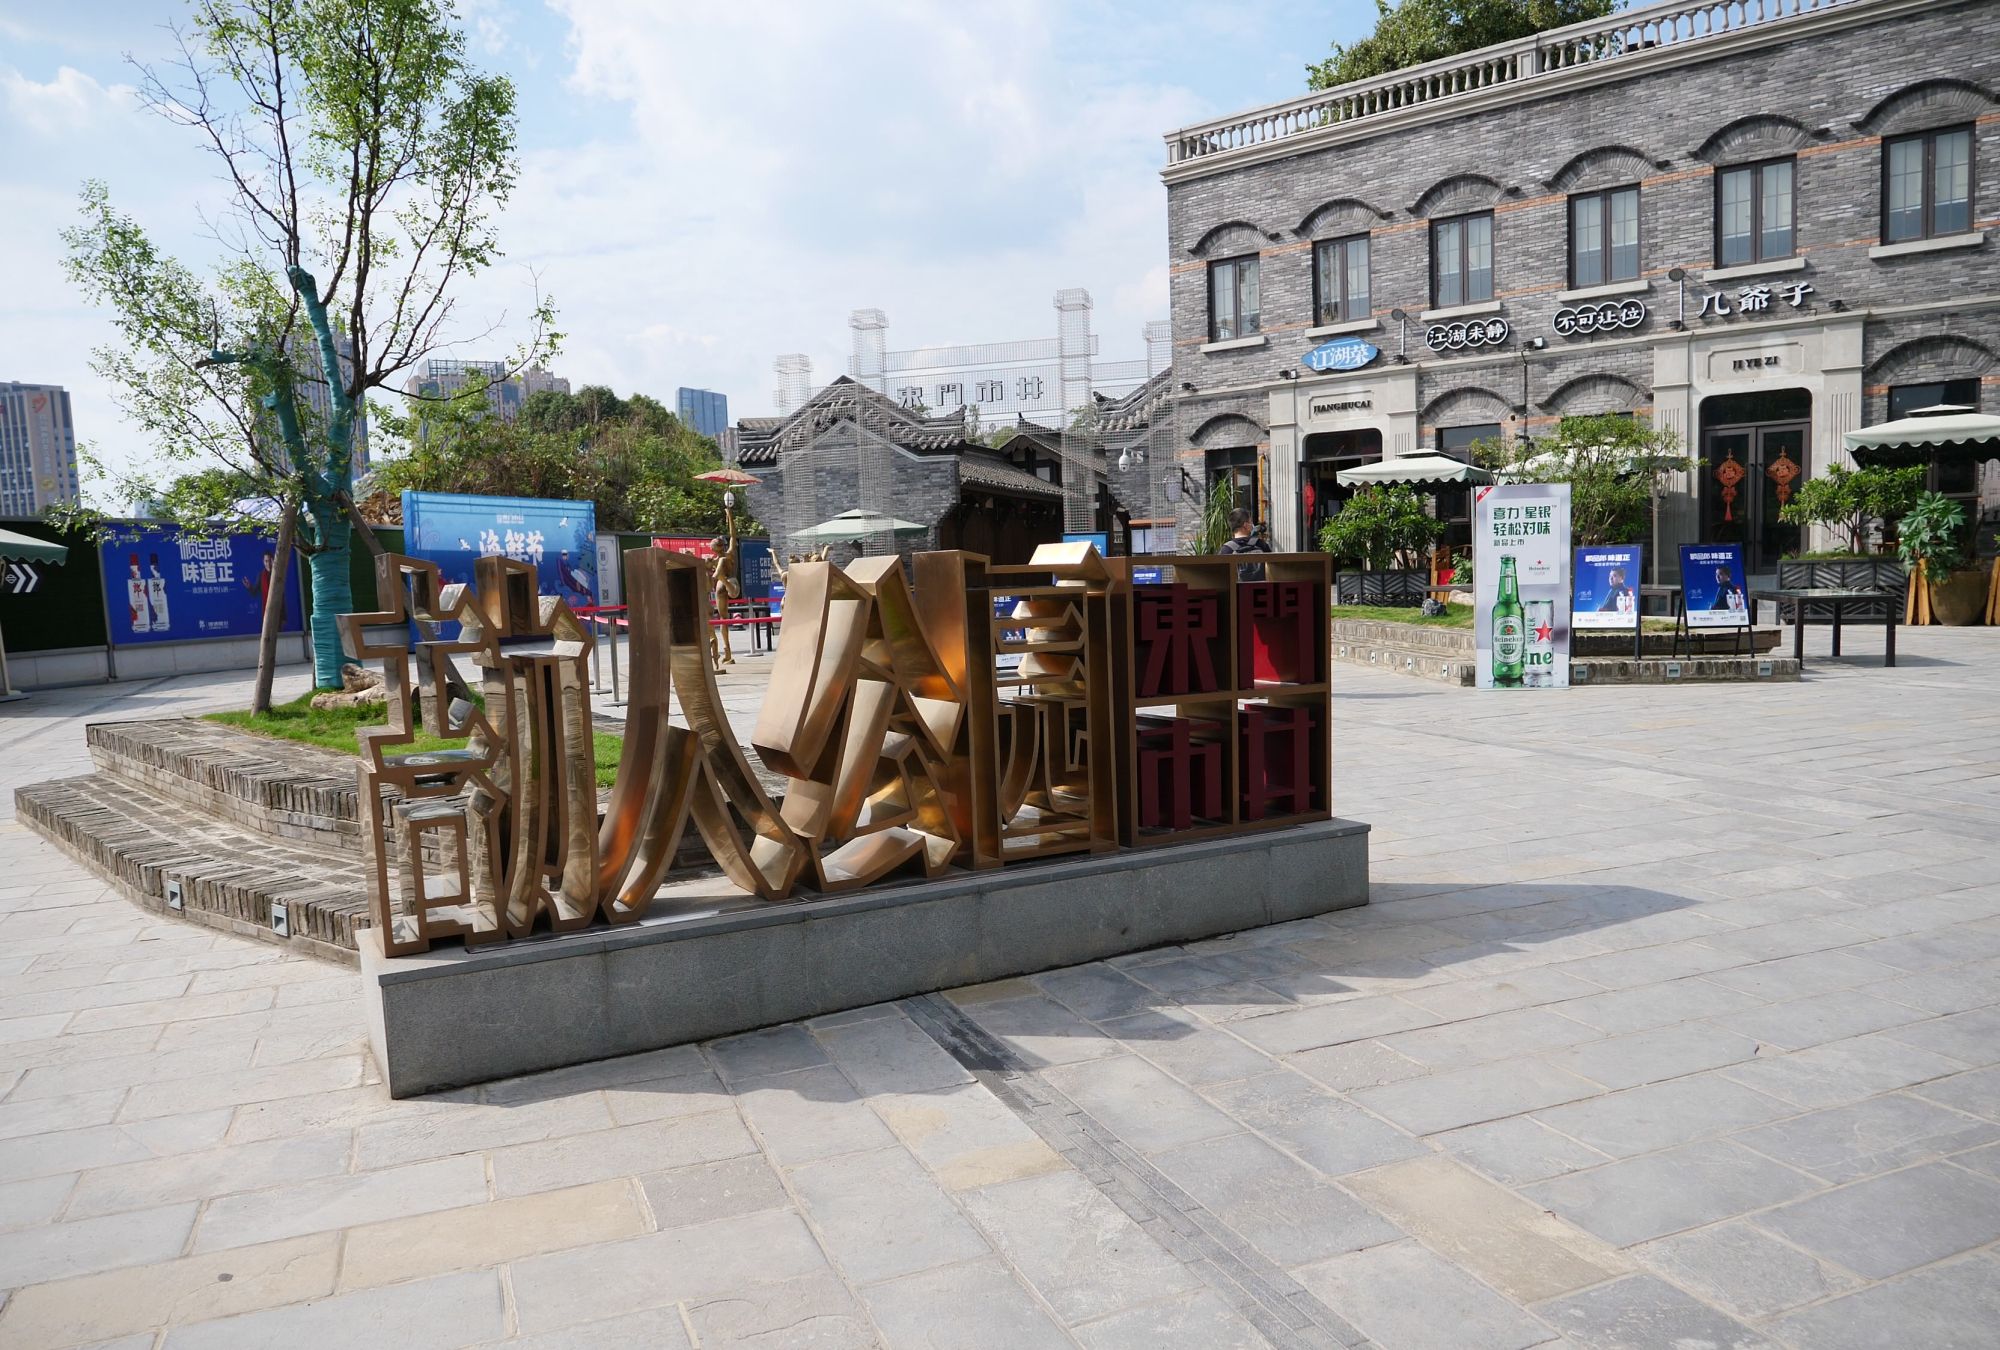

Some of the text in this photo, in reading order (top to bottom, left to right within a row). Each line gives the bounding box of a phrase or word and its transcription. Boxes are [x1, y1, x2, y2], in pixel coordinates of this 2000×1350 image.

[1557, 307, 1641, 330] 不可让位
[1429, 323, 1505, 345] 江湖未静
[1312, 345, 1371, 369] 江湖菜
[1765, 356, 1778, 366] ZI
[897, 377, 1044, 408] 東門市井
[1313, 400, 1372, 414] JIANGHUCAI
[1493, 521, 1551, 536] 轻松对味
[1493, 539, 1525, 547] 新品上市
[181, 561, 235, 583] 味道正
